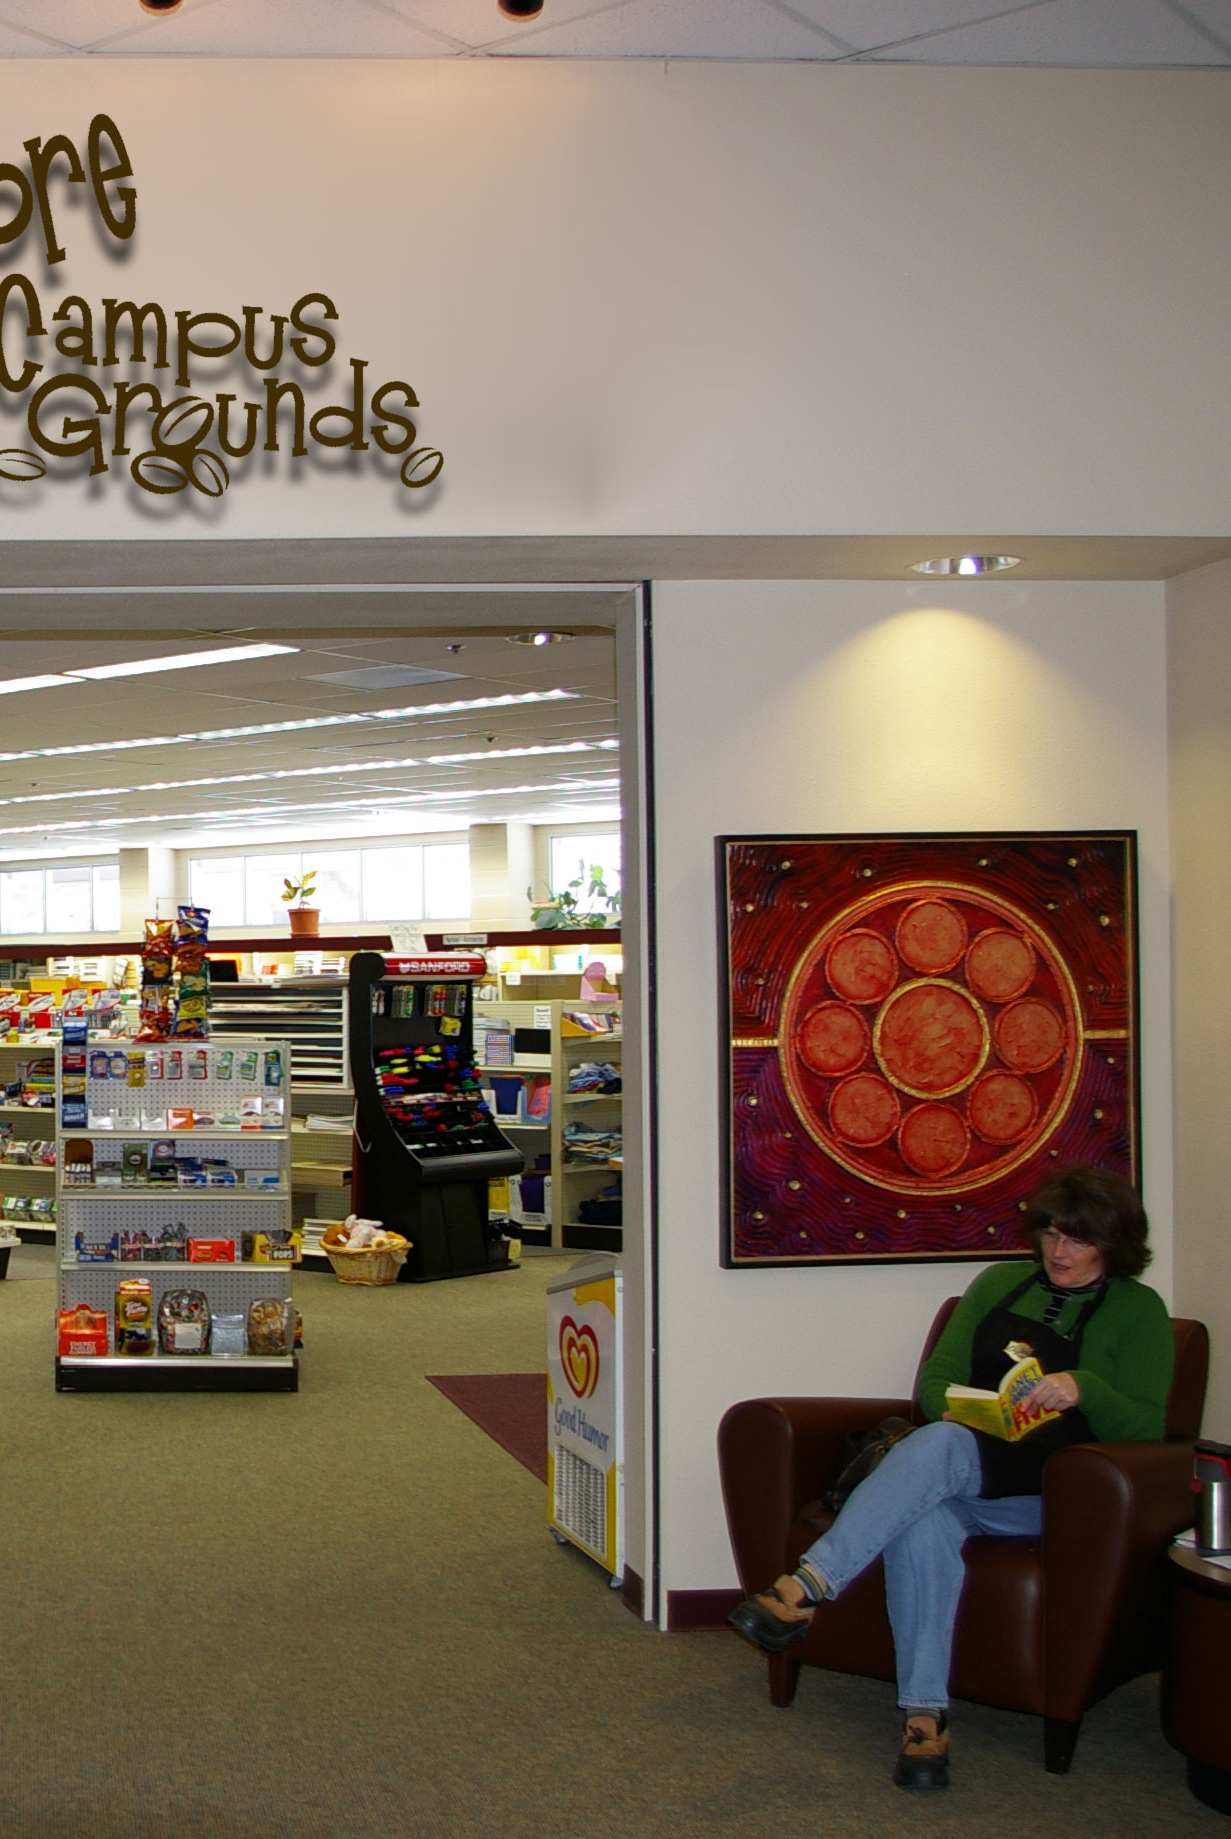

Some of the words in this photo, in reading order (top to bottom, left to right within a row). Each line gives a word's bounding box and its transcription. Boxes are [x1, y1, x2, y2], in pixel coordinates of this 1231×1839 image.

[28, 358, 420, 480] Grounds
[410, 961, 470, 973] SANFORD
[555, 1397, 577, 1436] Good
[578, 1408, 609, 1452] Humor
